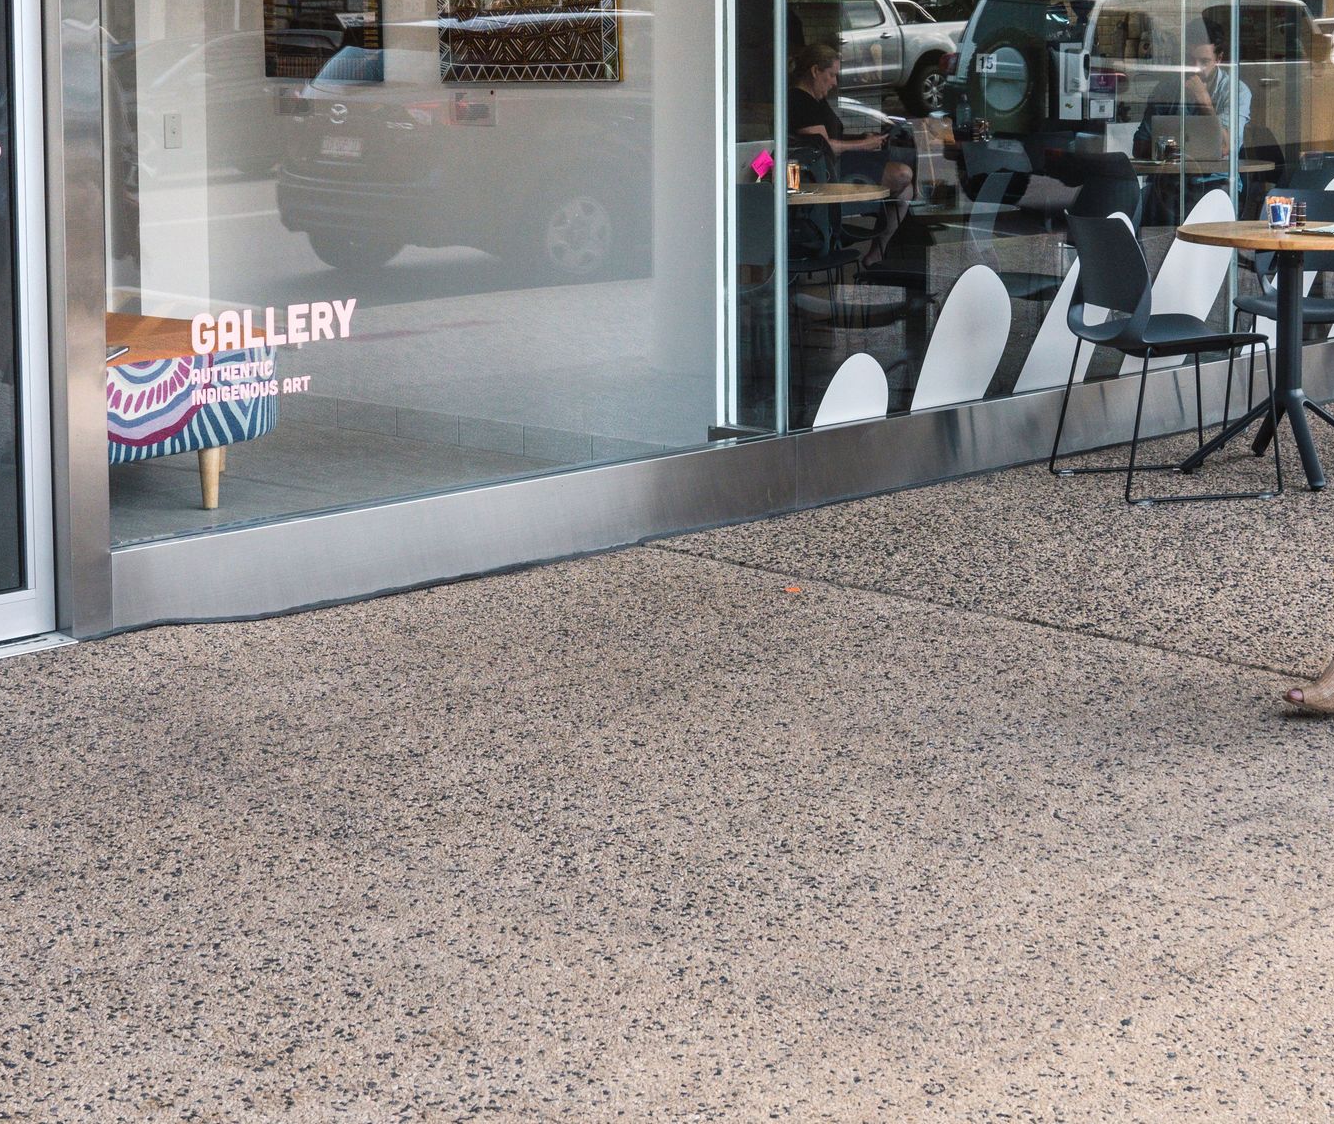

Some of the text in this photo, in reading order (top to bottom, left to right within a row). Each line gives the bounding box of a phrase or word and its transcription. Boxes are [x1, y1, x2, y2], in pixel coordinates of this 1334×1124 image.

[978, 55, 994, 71] 15
[191, 298, 357, 355] GALLERY
[191, 359, 275, 386] AUTHENTIC
[191, 375, 312, 406] INDIGENOUS ART
